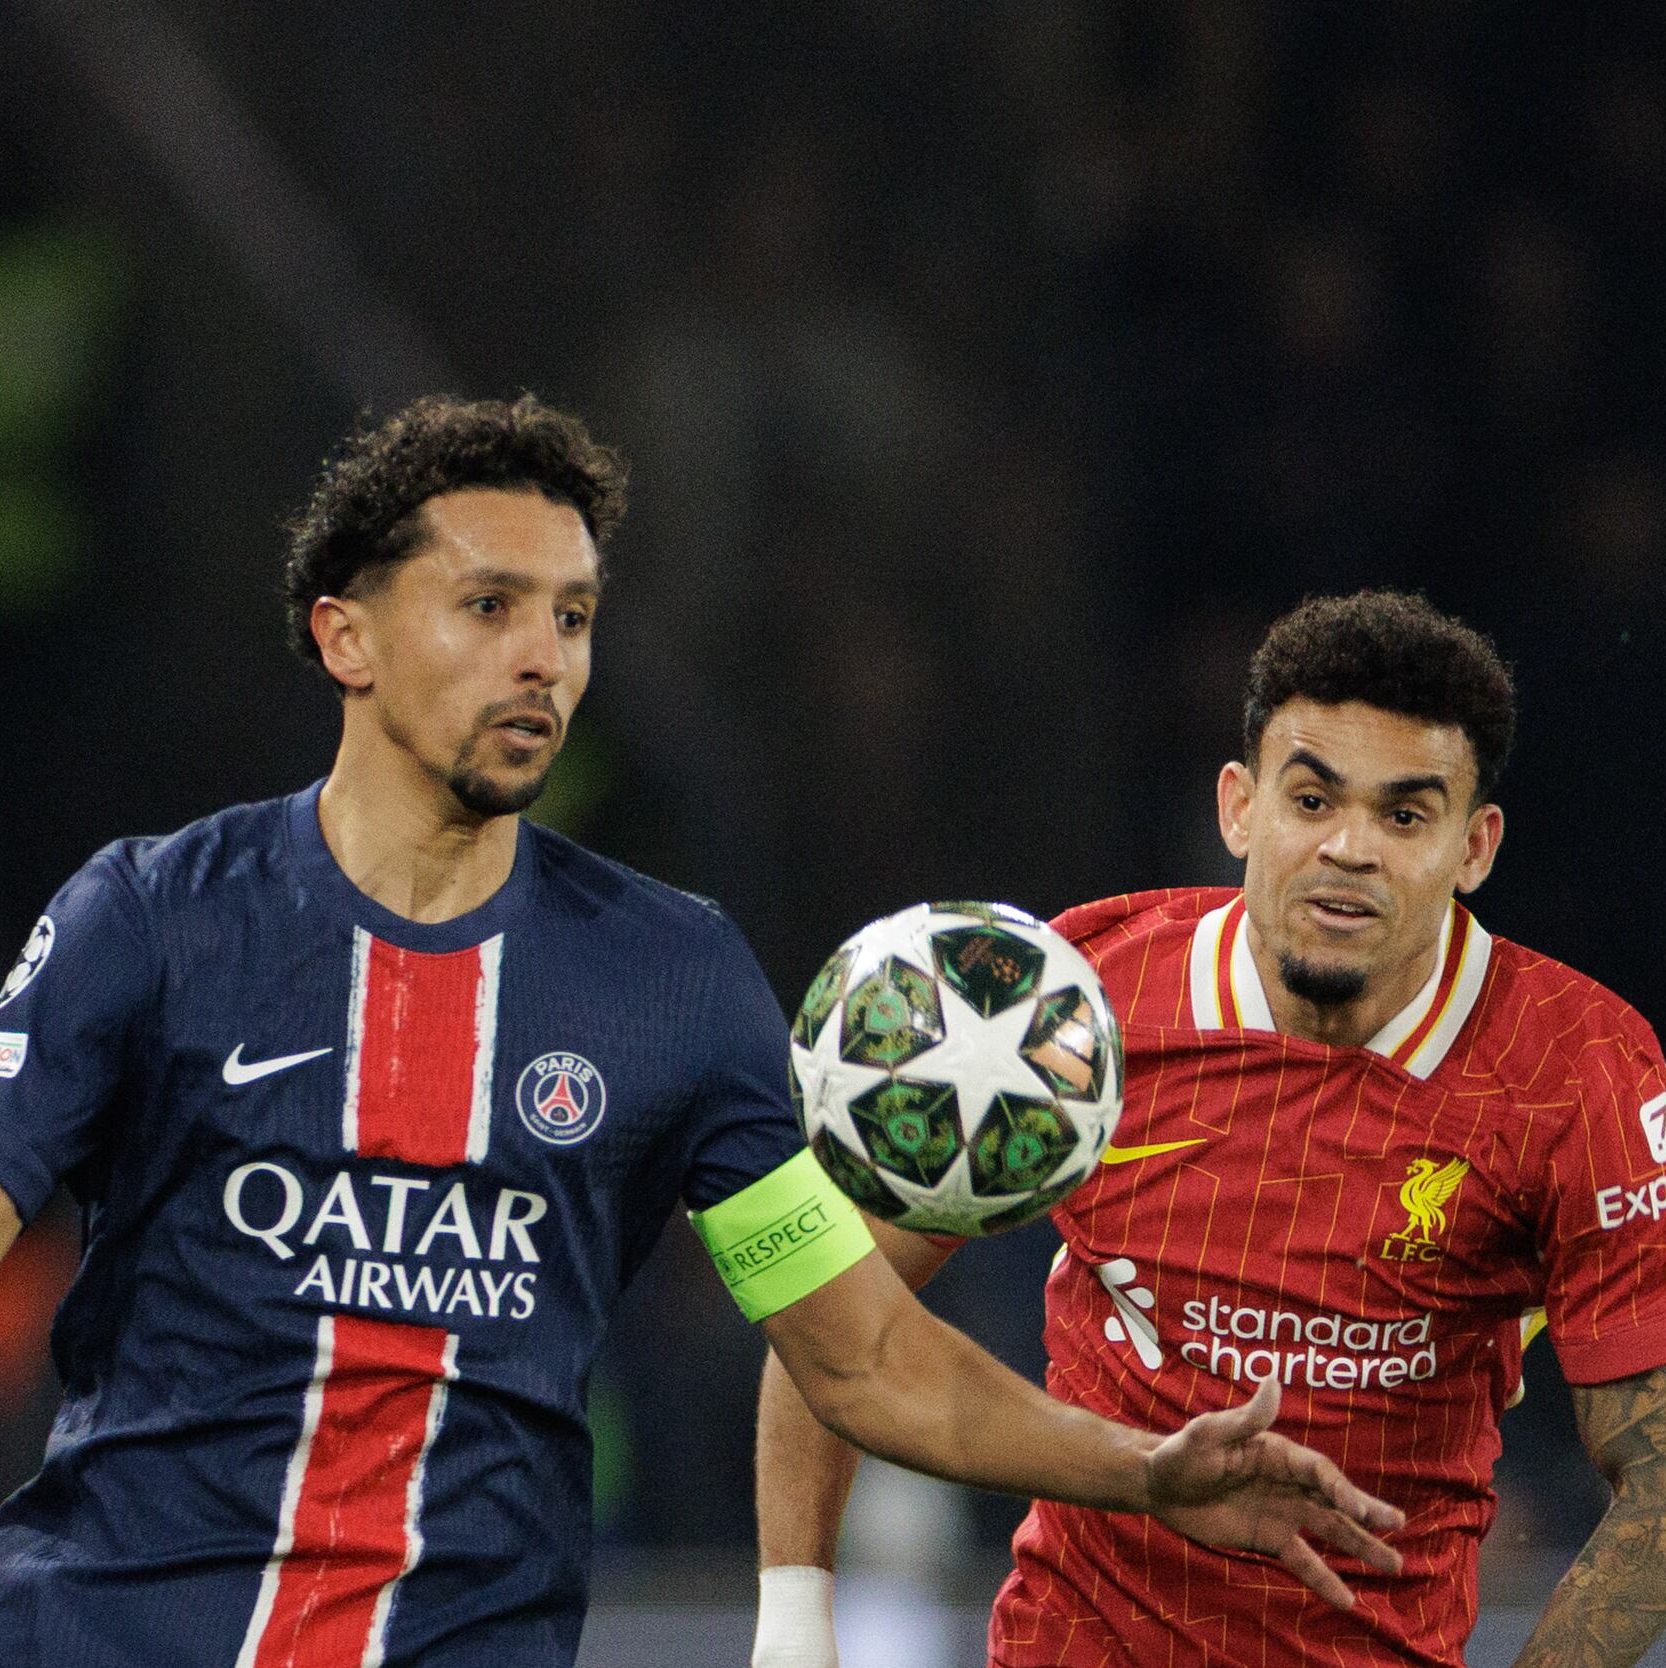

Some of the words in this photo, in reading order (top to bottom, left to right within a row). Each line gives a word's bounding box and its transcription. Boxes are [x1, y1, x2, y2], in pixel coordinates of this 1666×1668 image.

[534, 1056, 593, 1083] PARIS
[222, 1161, 549, 1264] QATAR
[733, 1202, 828, 1272] RESPECT
[293, 1253, 538, 1321] AIRWAYS
[1182, 1295, 1433, 1352] standard
[1181, 1336, 1437, 1390] chartered
